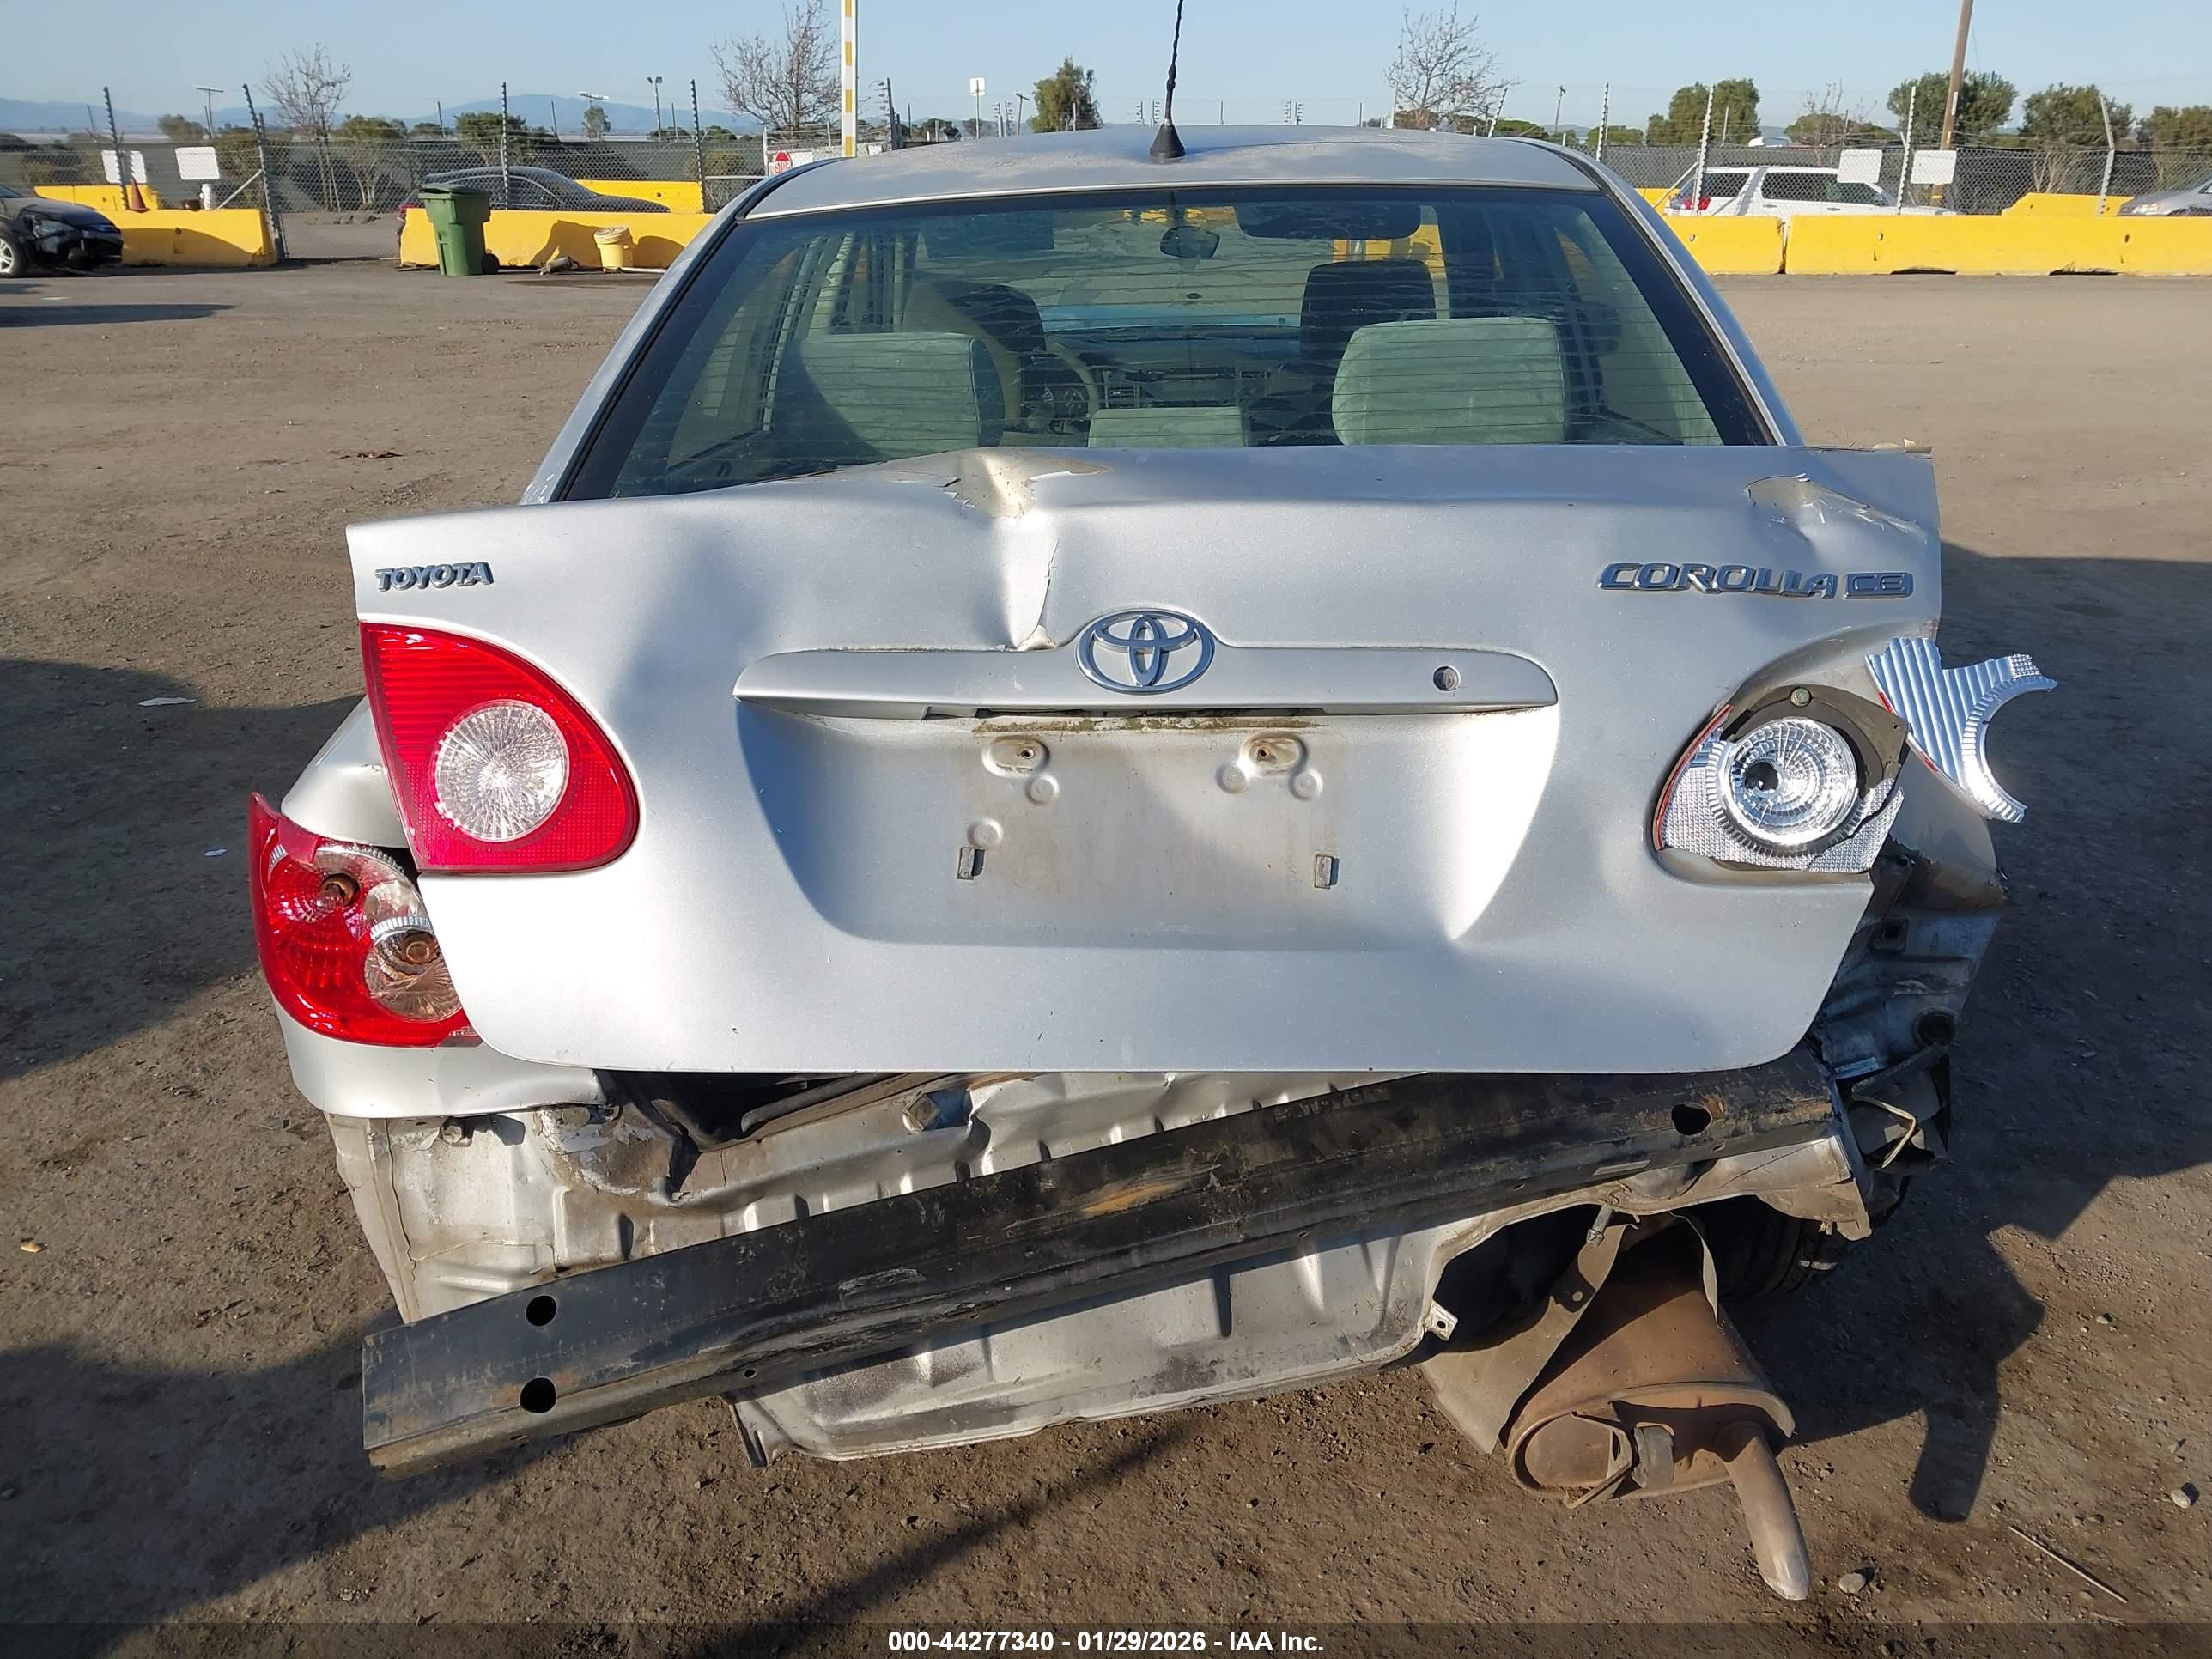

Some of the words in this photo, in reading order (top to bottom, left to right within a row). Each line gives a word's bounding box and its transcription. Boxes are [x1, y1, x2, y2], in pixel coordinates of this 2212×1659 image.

[775, 161, 790, 173] STOP
[375, 562, 494, 592] TOYOTA
[1598, 563, 1838, 599] COROLLA
[1850, 574, 1907, 595] CE
